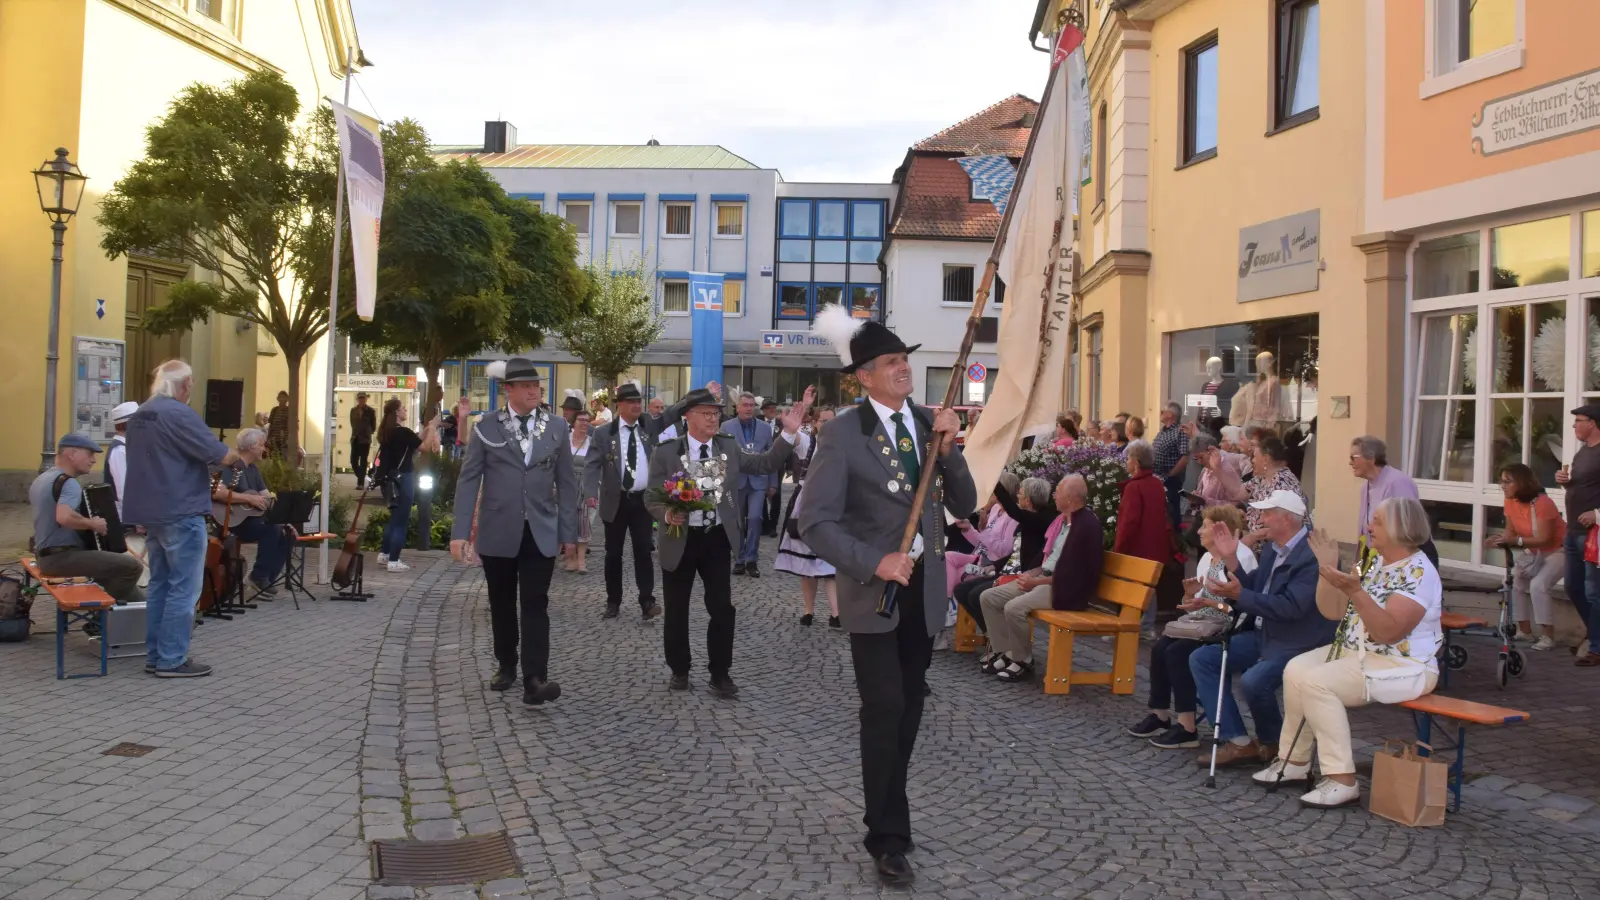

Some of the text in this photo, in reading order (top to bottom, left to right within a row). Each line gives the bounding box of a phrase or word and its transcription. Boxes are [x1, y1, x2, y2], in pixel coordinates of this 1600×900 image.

[1495, 126, 1517, 143] von
[1518, 112, 1568, 136] Wilhelm
[1292, 226, 1306, 246] and
[1299, 236, 1317, 252] more
[1238, 242, 1281, 278] Jeans
[788, 334, 804, 345] VR
